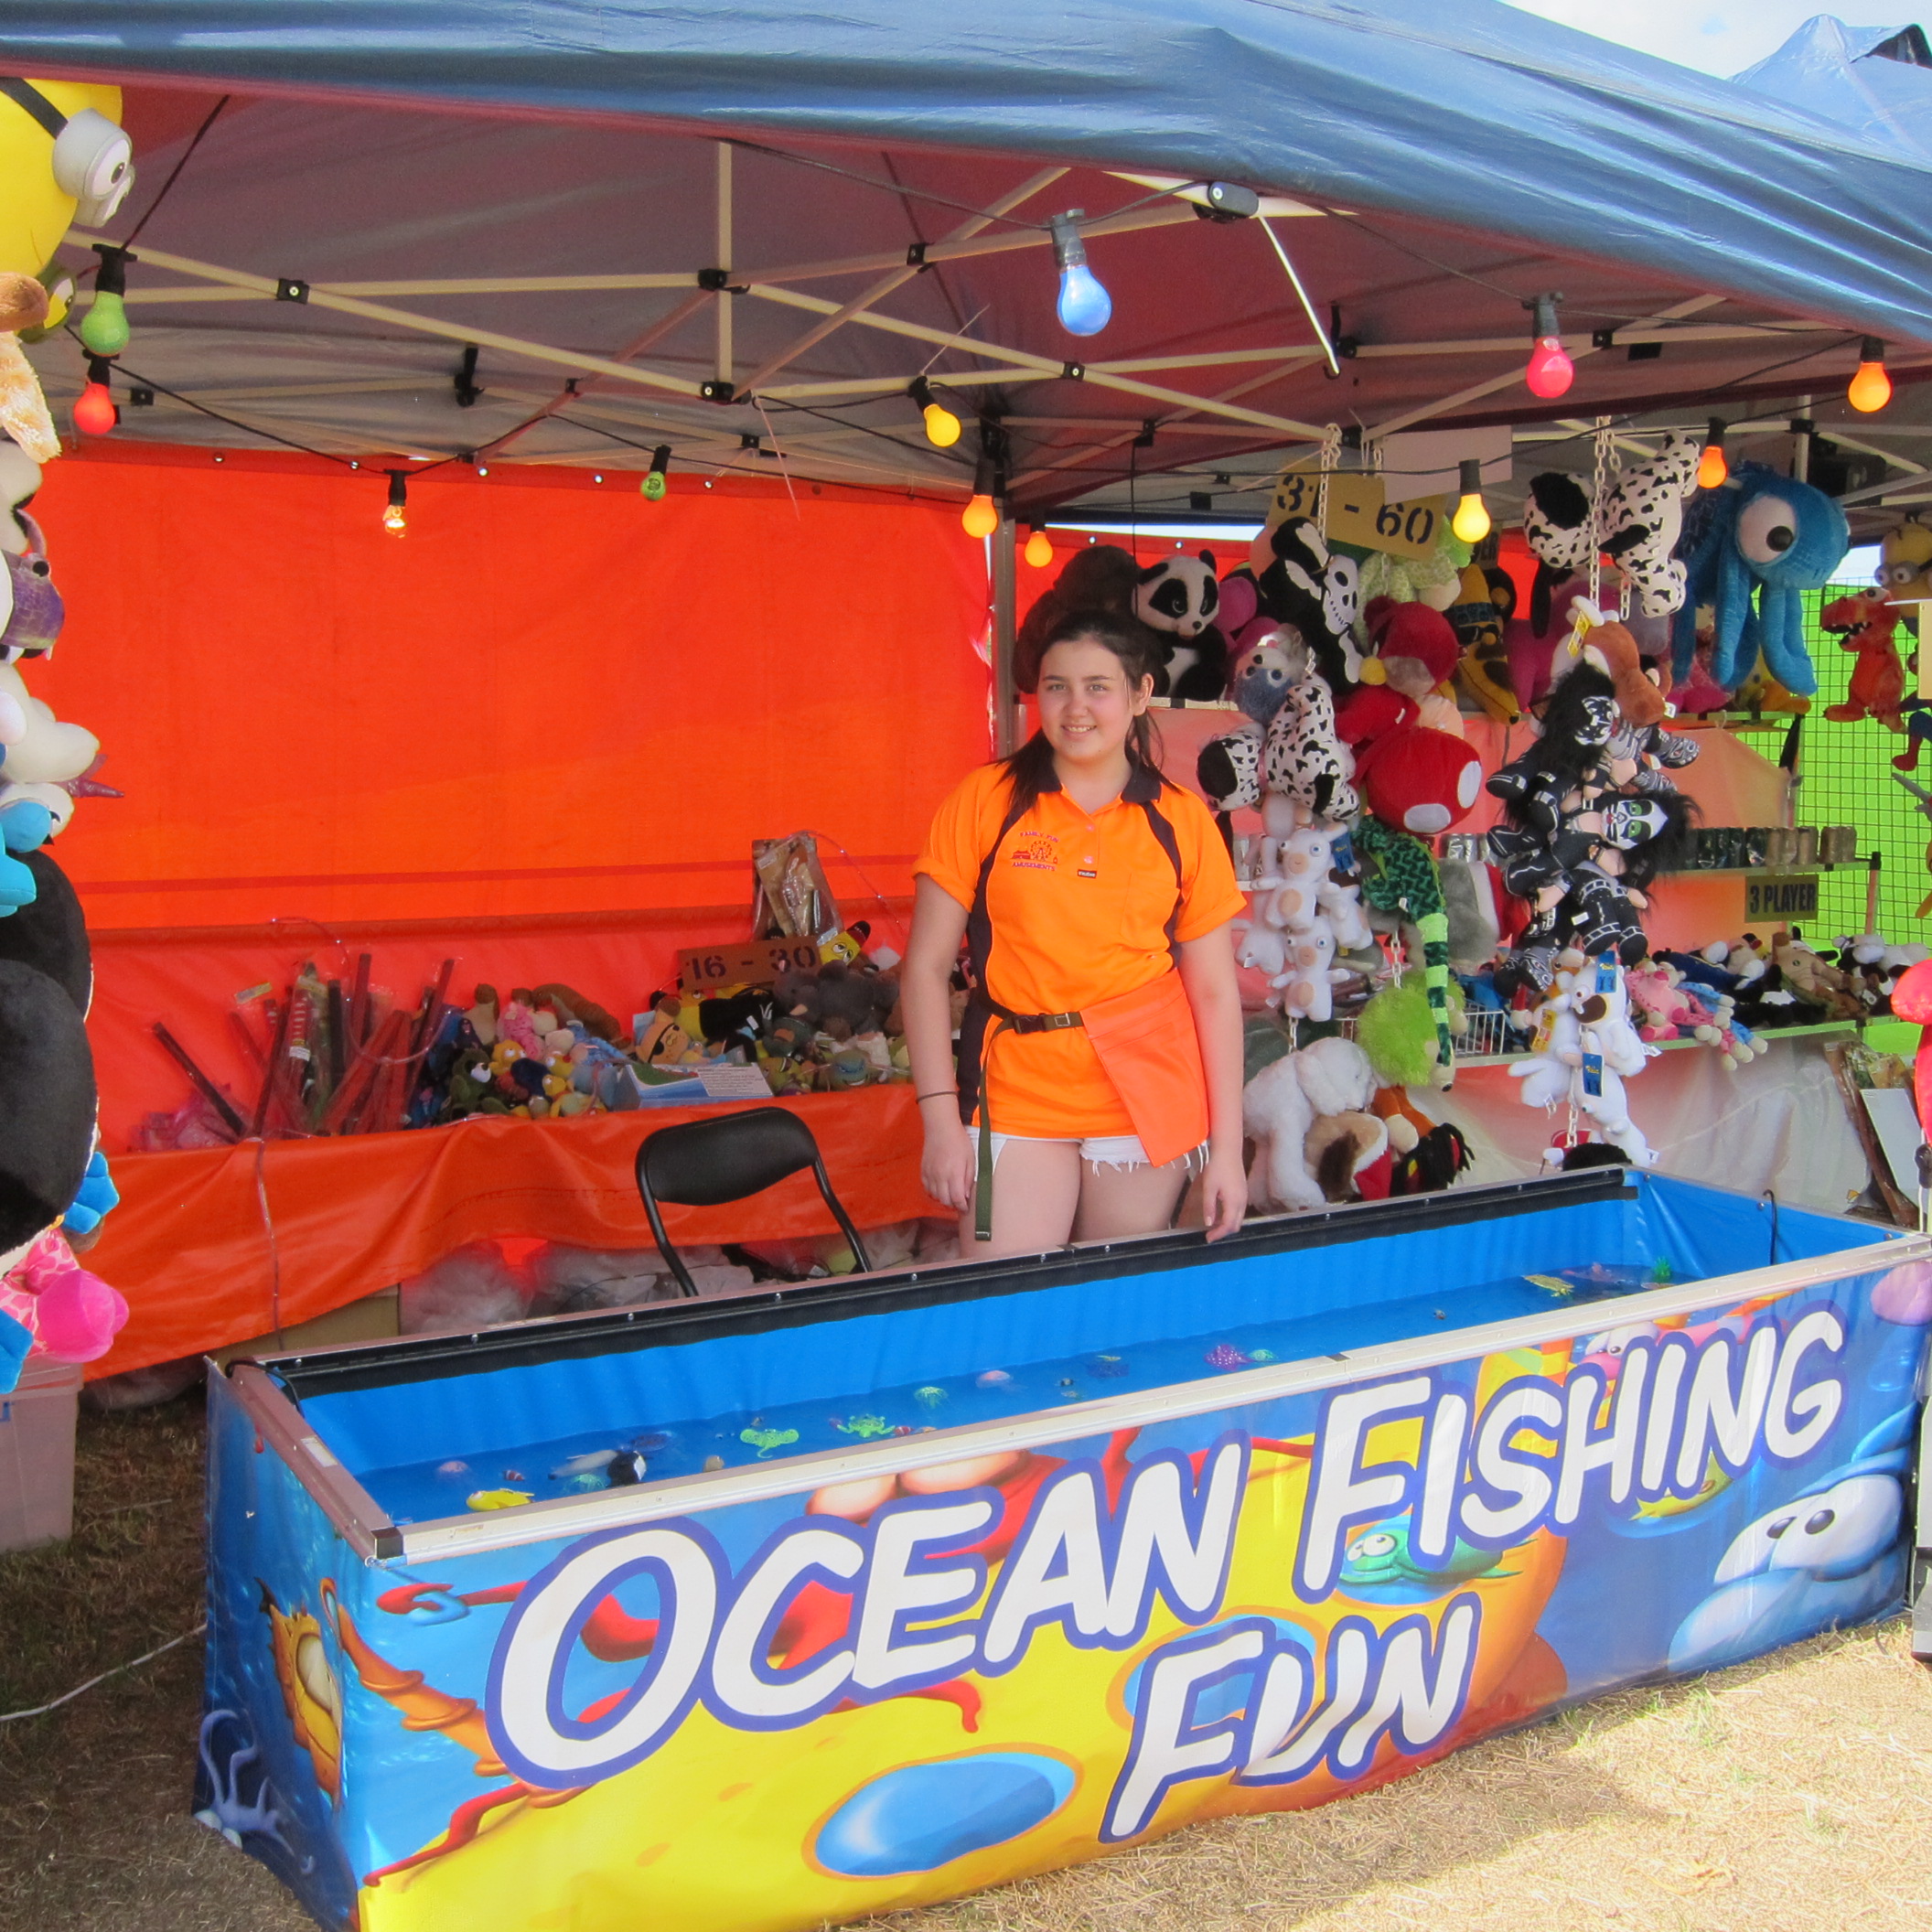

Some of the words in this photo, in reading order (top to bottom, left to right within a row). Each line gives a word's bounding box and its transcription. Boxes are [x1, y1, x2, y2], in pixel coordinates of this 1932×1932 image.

[1375, 502, 1434, 544] 60
[1749, 885, 1761, 914] 3
[1763, 883, 1817, 913] PLAYER
[686, 954, 727, 981] 16
[768, 945, 816, 973] 30
[495, 1439, 1244, 1776] OCEAN
[1299, 1306, 1847, 1594] FISHING
[1105, 1600, 1477, 1840] FUN
